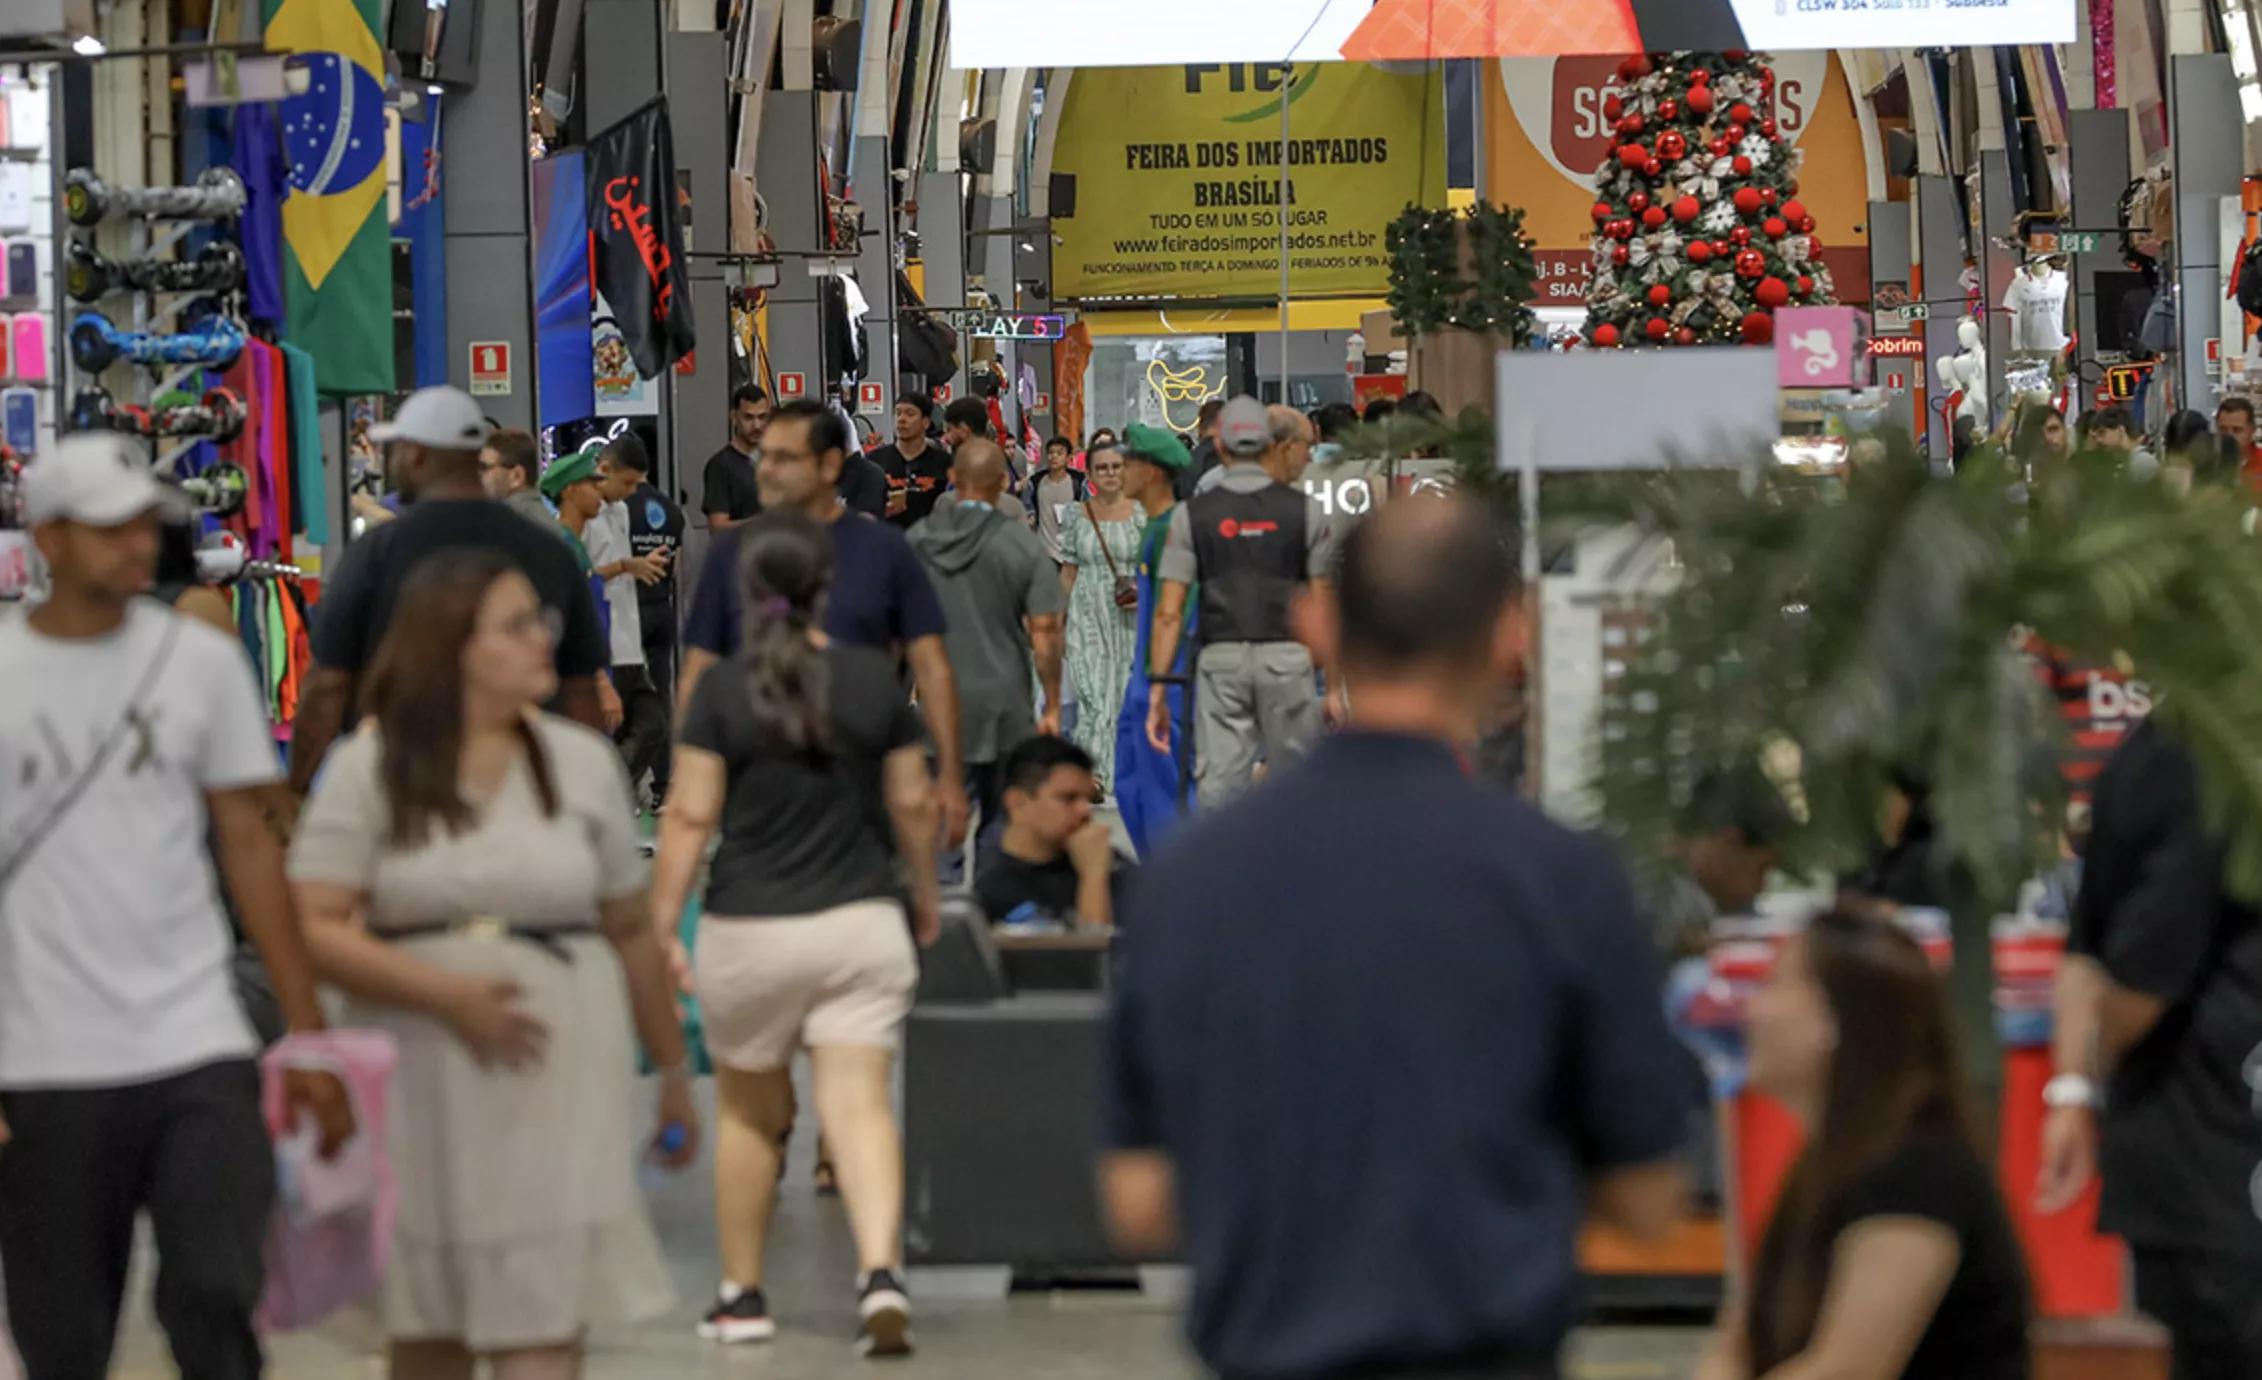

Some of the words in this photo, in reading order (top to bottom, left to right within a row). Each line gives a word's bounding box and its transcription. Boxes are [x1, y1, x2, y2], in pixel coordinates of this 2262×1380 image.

[1126, 144, 1190, 170] FEIRA
[1196, 142, 1239, 168] DOS
[1246, 138, 1388, 167] IMPORTADOS
[1194, 174, 1297, 207] BRASÍLIA
[1150, 213, 1192, 229] TUDO
[1195, 212, 1218, 228] EM
[1222, 212, 1247, 228] UM
[1252, 208, 1274, 227] SÓ
[1082, 260, 1177, 275] FUNCIONAMENTO
[1180, 259, 1215, 274] TERÇA
[1216, 259, 1225, 272] A
[1228, 258, 1279, 271] DOMINGO
[1291, 255, 1346, 270] FERIADOS
[1348, 254, 1363, 267] DE
[1554, 262, 1567, 276] B
